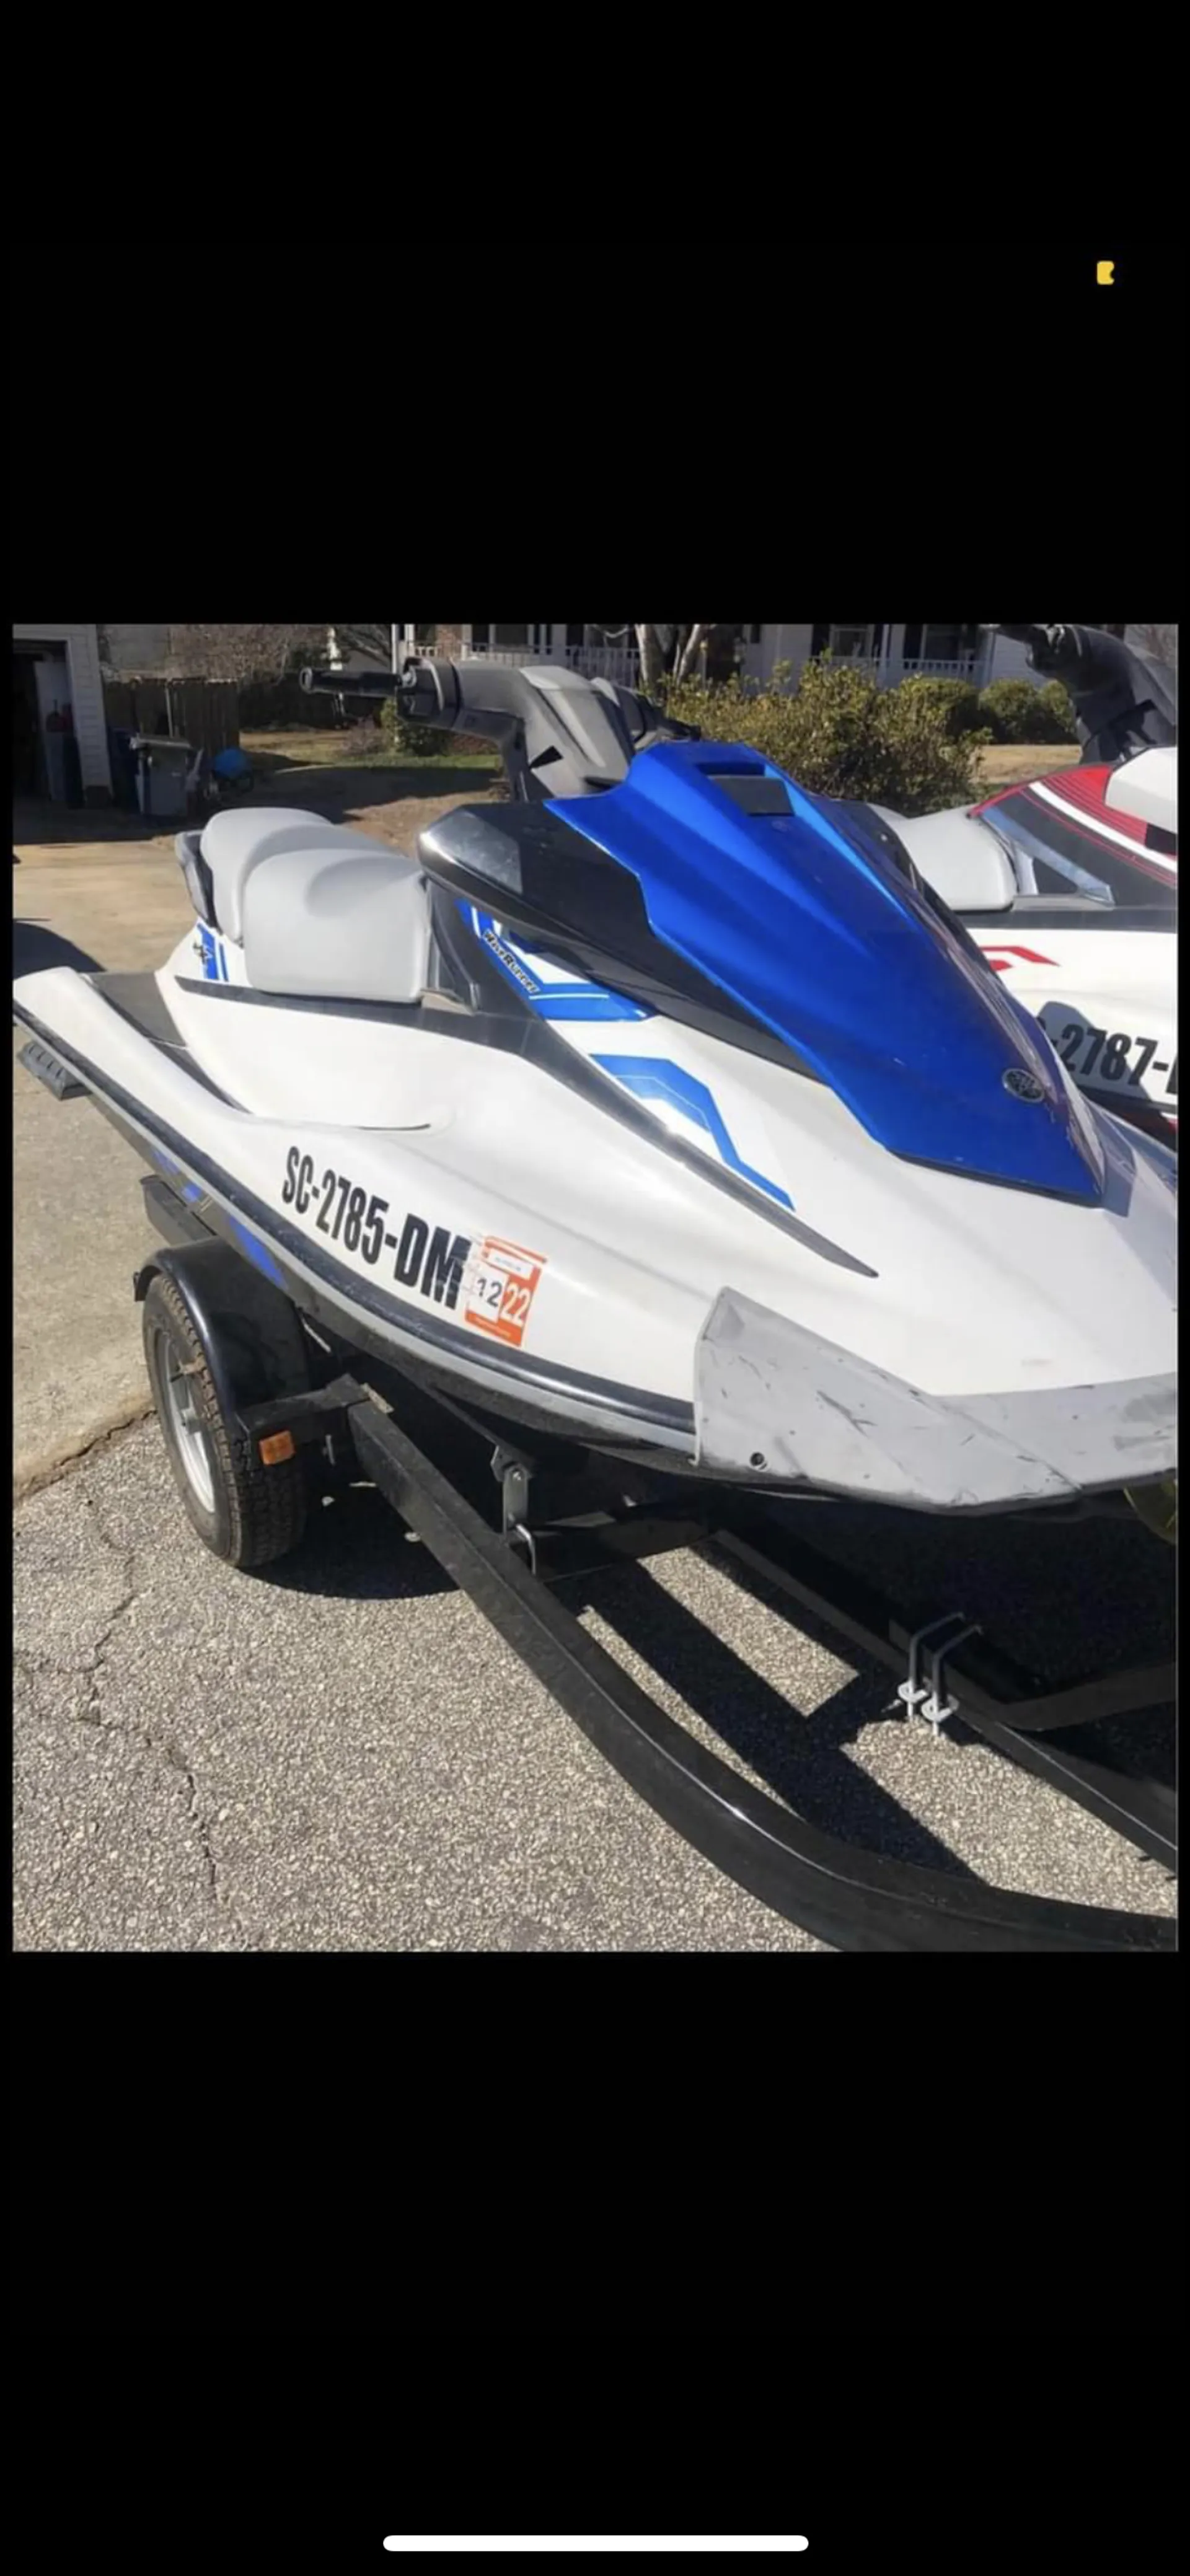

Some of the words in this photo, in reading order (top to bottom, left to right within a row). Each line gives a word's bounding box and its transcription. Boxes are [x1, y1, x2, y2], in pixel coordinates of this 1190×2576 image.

[1037, 1017, 1178, 1095] -2787-
[282, 1146, 472, 1310] SC-2785-DM
[477, 1277, 503, 1308] 12
[500, 1282, 531, 1326] 22
